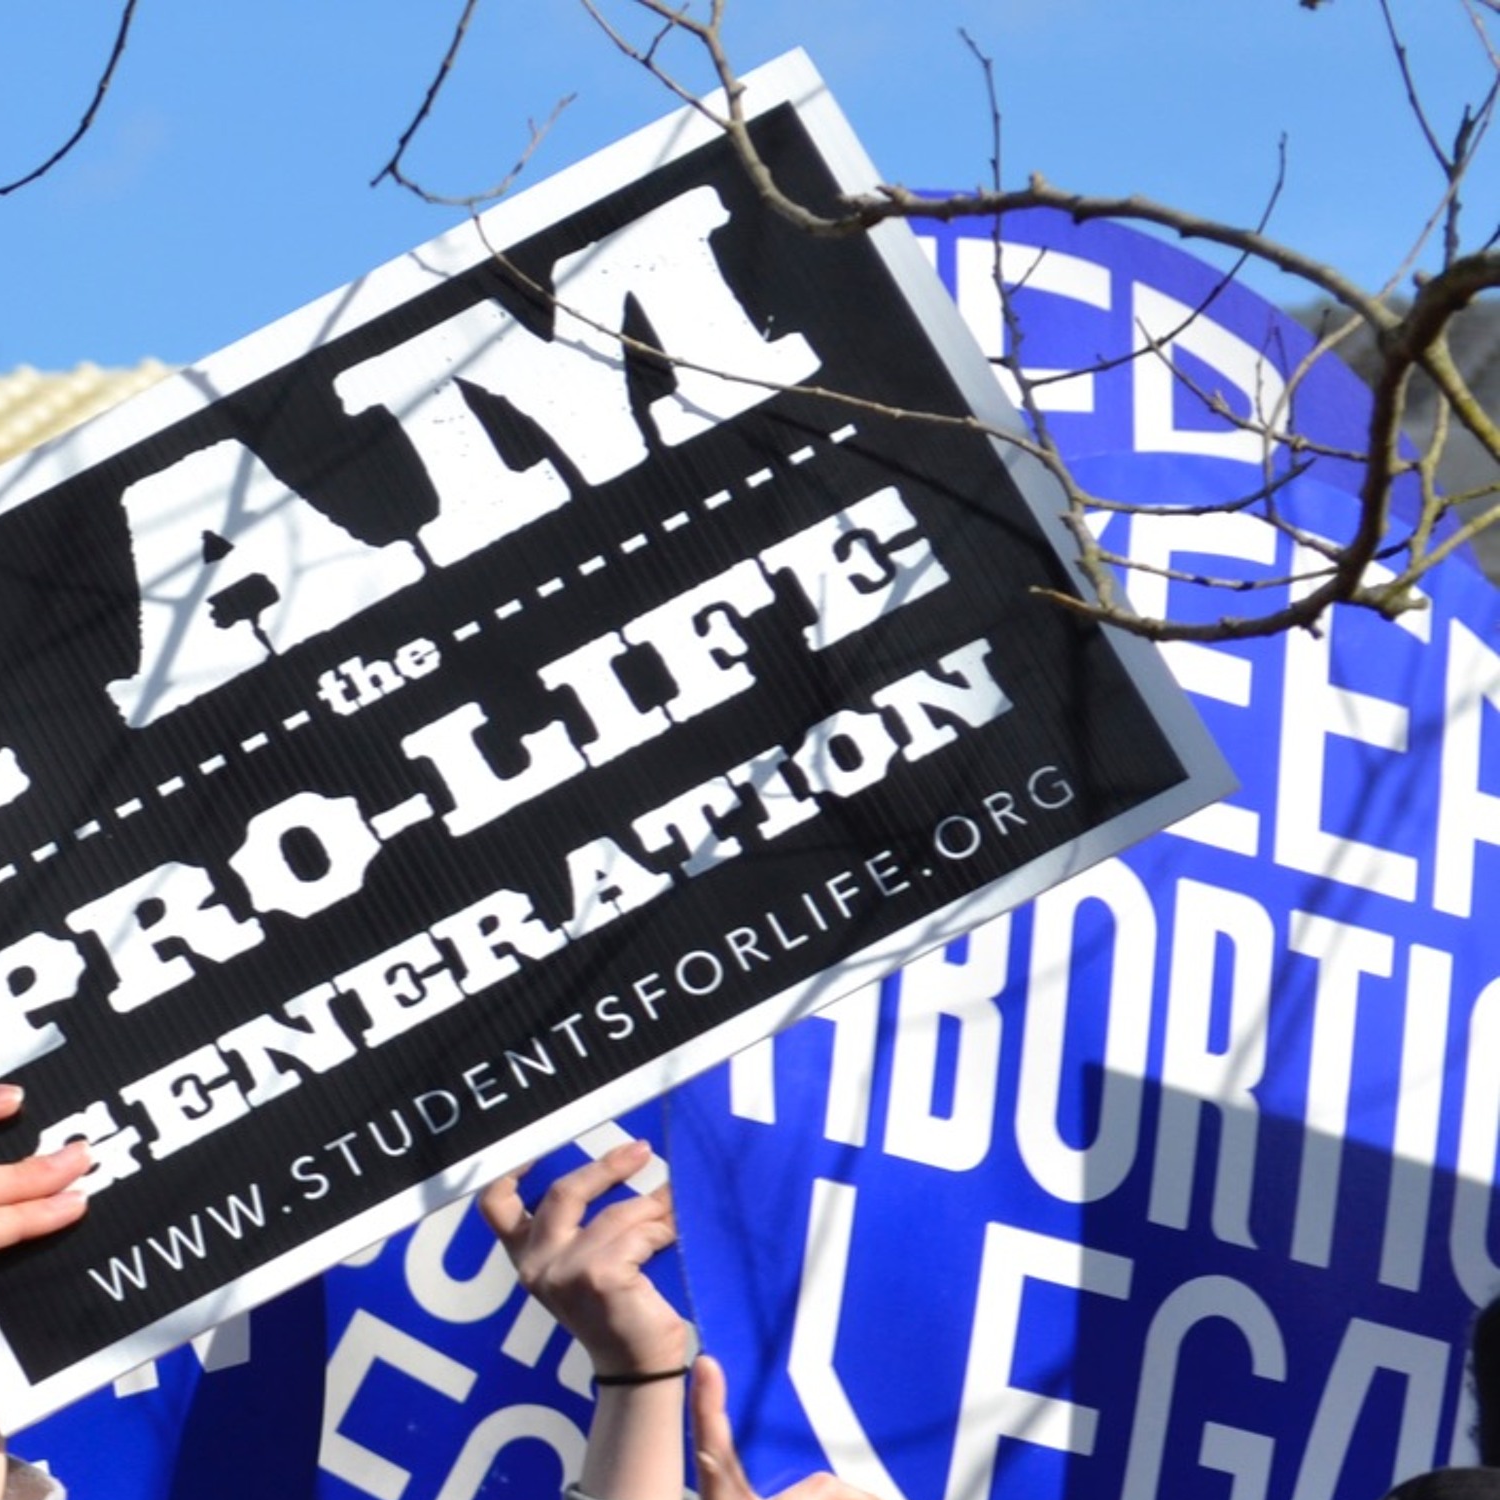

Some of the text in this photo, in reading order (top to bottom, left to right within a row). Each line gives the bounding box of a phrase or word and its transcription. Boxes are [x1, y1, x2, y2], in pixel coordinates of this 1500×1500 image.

[106, 185, 822, 729] AM
[317, 637, 441, 717] the
[34, 638, 1014, 1200] GENERATION
[87, 765, 1076, 1302] WWW.STUDENTSFORLIFE.ORG
